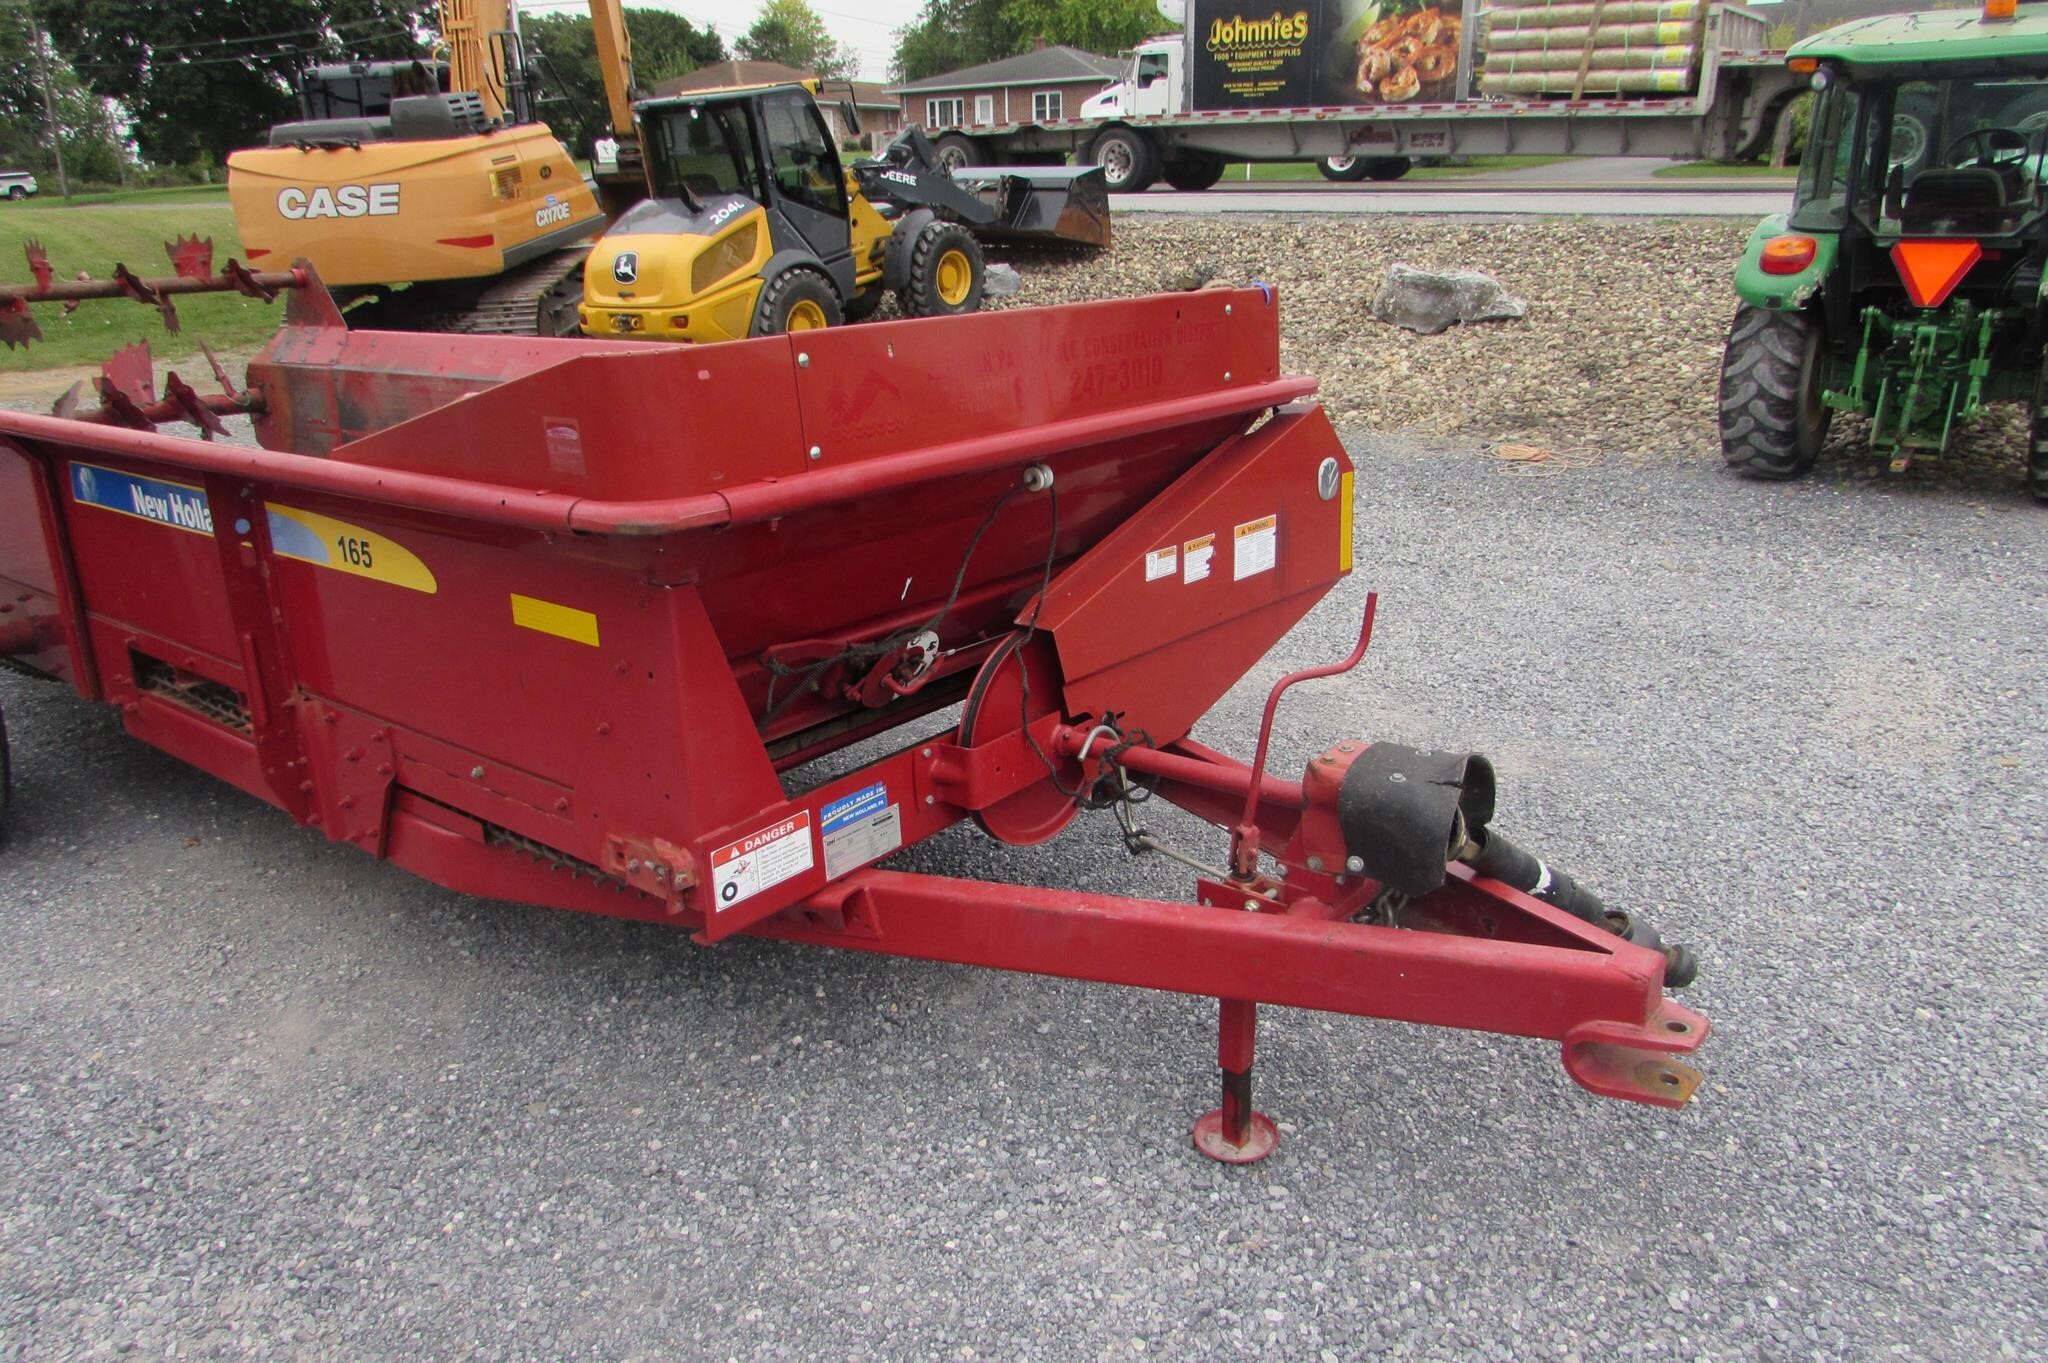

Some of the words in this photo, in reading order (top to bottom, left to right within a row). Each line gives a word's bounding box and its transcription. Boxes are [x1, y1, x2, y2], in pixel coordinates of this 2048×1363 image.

[1214, 52, 1230, 61] FOOD
[1235, 50, 1267, 60] EQUIPMENT
[1273, 48, 1302, 58] SUPPLIES
[881, 170, 917, 187] DEERE
[278, 183, 400, 220] CASE
[710, 201, 745, 225] 204L
[129, 483, 169, 521] New
[337, 535, 373, 568] 165
[823, 800, 854, 821] PROUDLY
[856, 790, 874, 802] MADE
[876, 786, 884, 794] IN
[842, 812, 855, 822] NEW
[744, 821, 795, 851] DANGER
